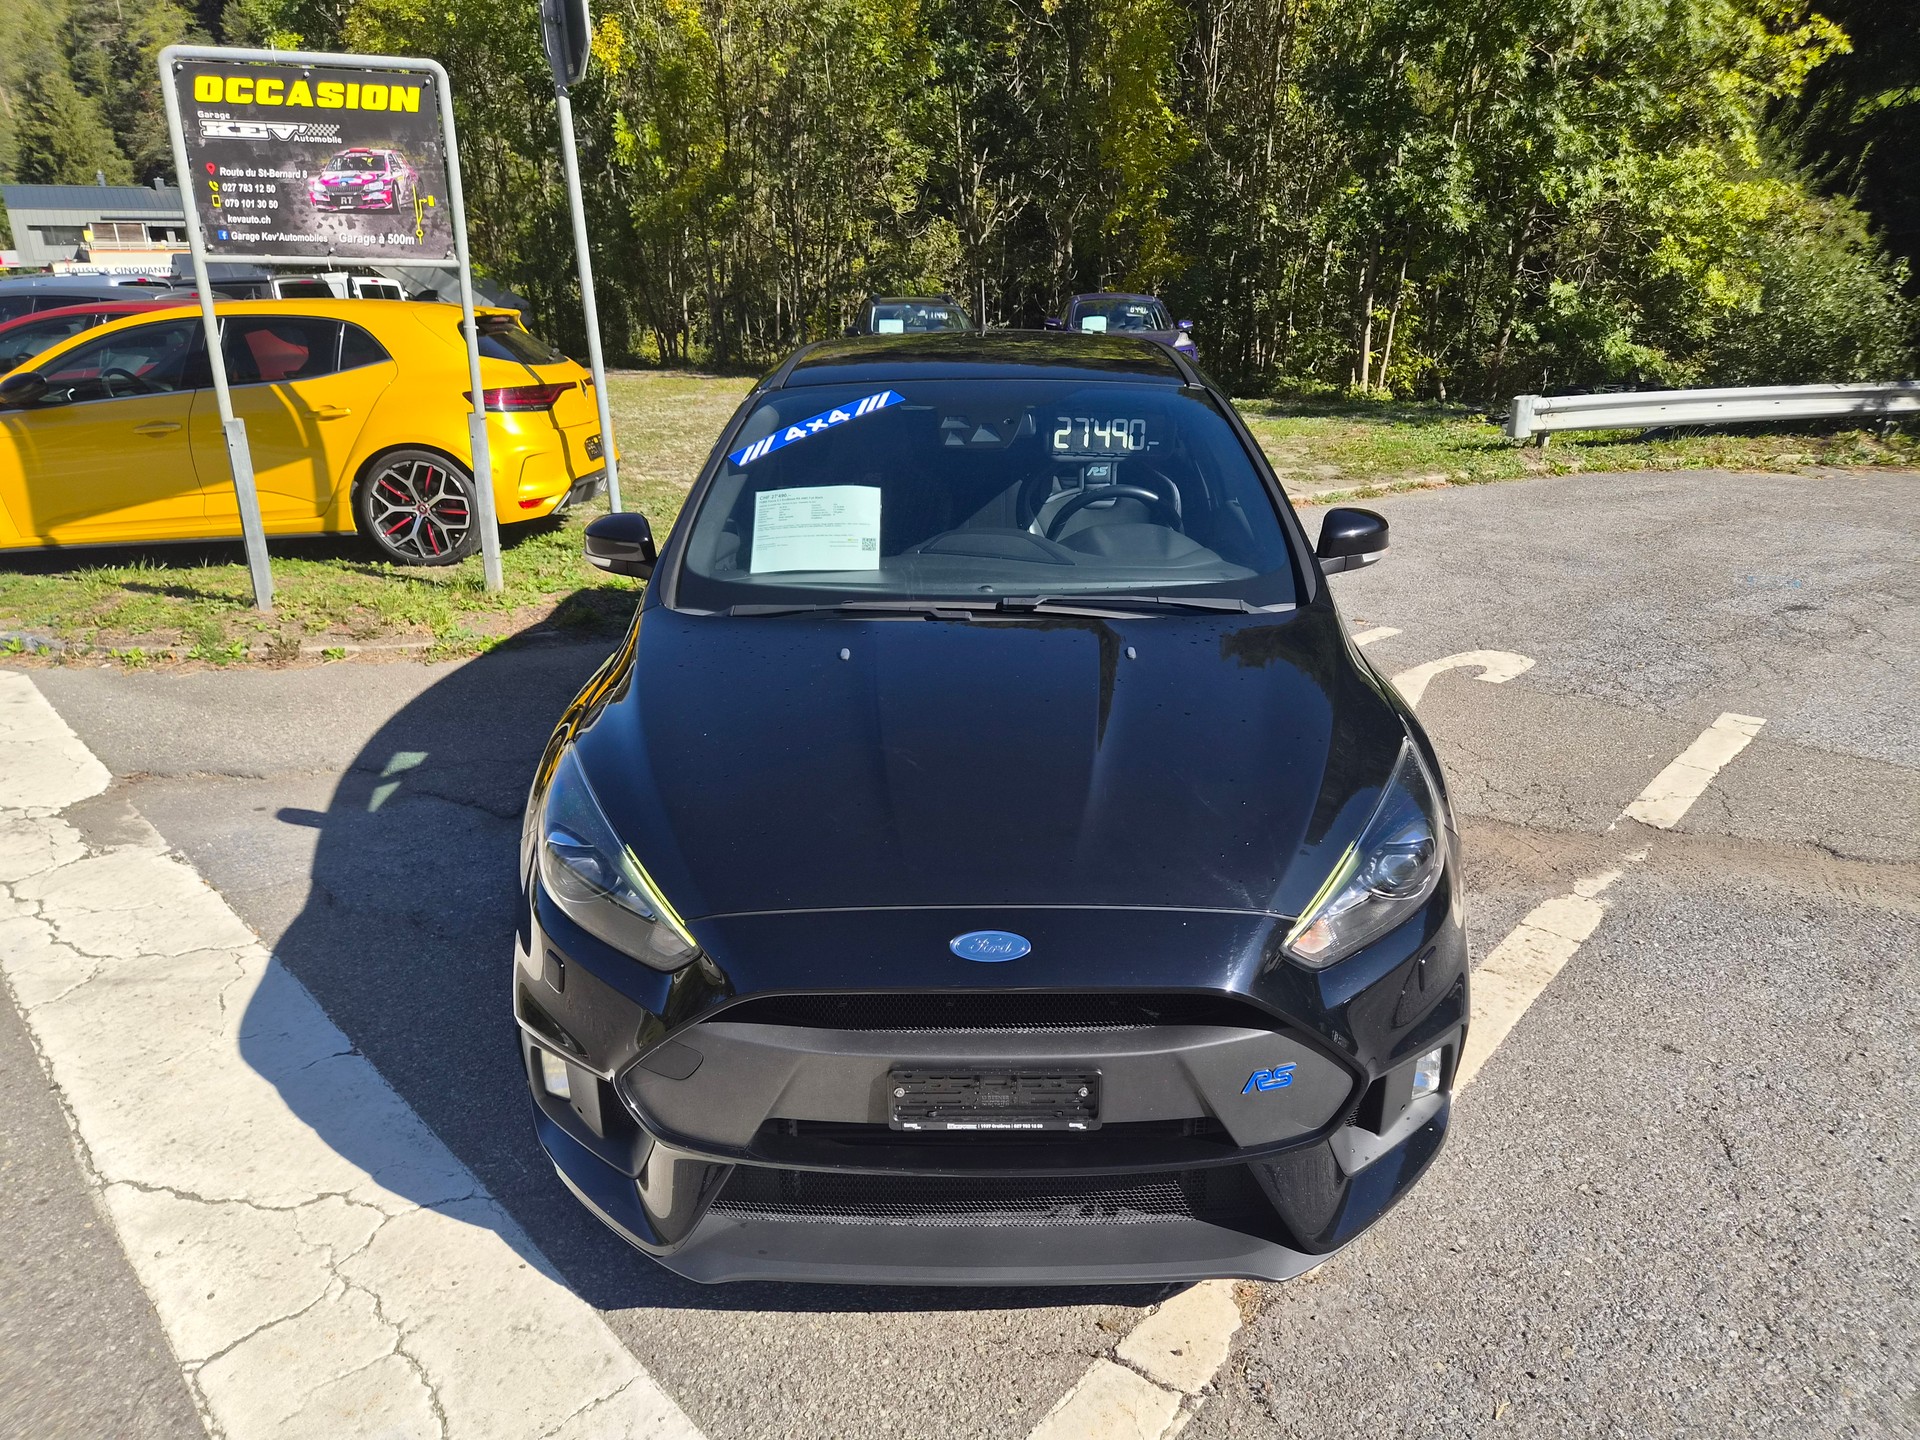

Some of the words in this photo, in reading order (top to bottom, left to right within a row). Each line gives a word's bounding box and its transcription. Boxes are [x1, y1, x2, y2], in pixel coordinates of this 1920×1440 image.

[194, 75, 420, 112] OCCASION
[197, 110, 231, 120] Garage
[293, 134, 343, 145] Automobile
[220, 167, 245, 177] Route
[246, 168, 257, 178] du
[258, 168, 301, 179] St-Bernard
[302, 170, 308, 179] 8
[222, 183, 237, 192] 027
[238, 184, 253, 193] 783
[254, 184, 265, 193] 12
[266, 184, 276, 194] 50
[225, 199, 239, 208] 079
[241, 199, 256, 208] 101
[257, 200, 267, 209] 30
[268, 200, 279, 209] 50
[340, 197, 353, 205] RT
[227, 214, 272, 225] kevauto.ch
[231, 232, 260, 243] Garage
[261, 232, 328, 243] Kev'Automobiles
[339, 234, 376, 246] Garage
[378, 233, 386, 242] à
[387, 234, 415, 245] 500m
[114, 266, 173, 275] CINQUANTA
[784, 409, 851, 442] 4x4
[1086, 466, 1109, 477] RS
[969, 937, 1012, 953] Ford
[1240, 1061, 1297, 1094] RS
